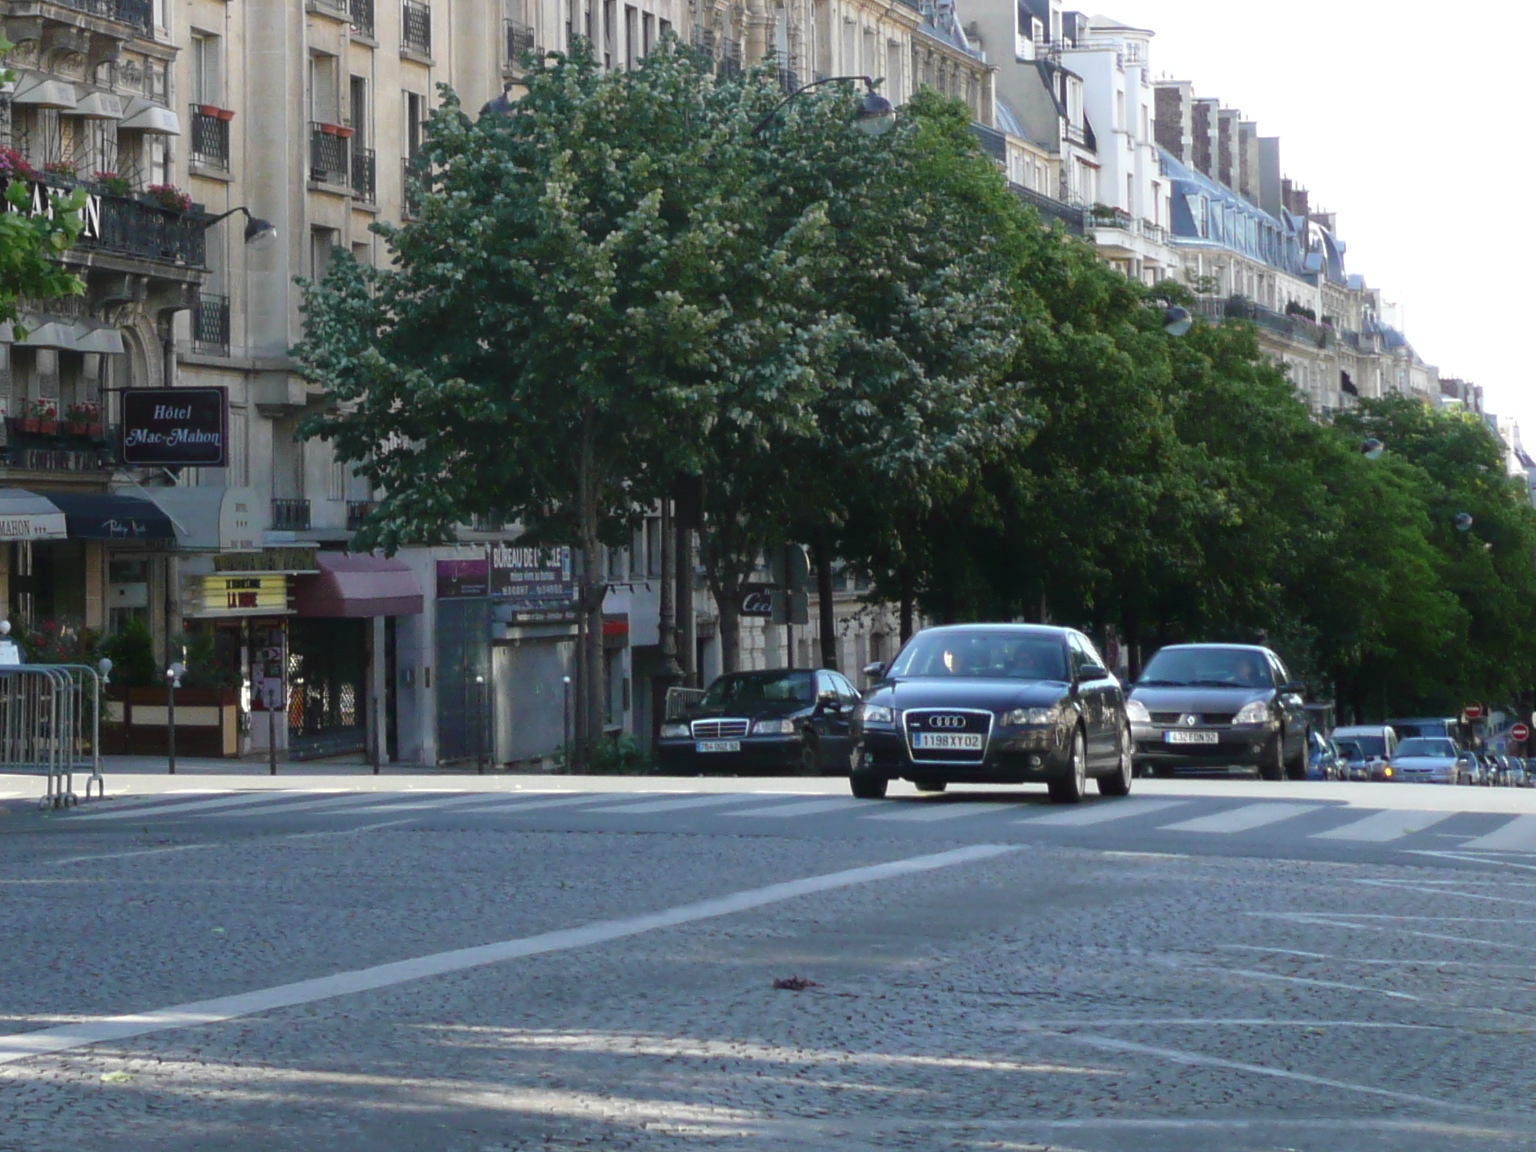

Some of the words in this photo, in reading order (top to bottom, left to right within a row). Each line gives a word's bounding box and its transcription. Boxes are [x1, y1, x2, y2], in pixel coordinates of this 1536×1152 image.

[153, 405, 192, 420] Hôtel
[125, 429, 221, 447] Mac-Mahon
[493, 548, 522, 568] BUREAU
[524, 548, 533, 567] DE
